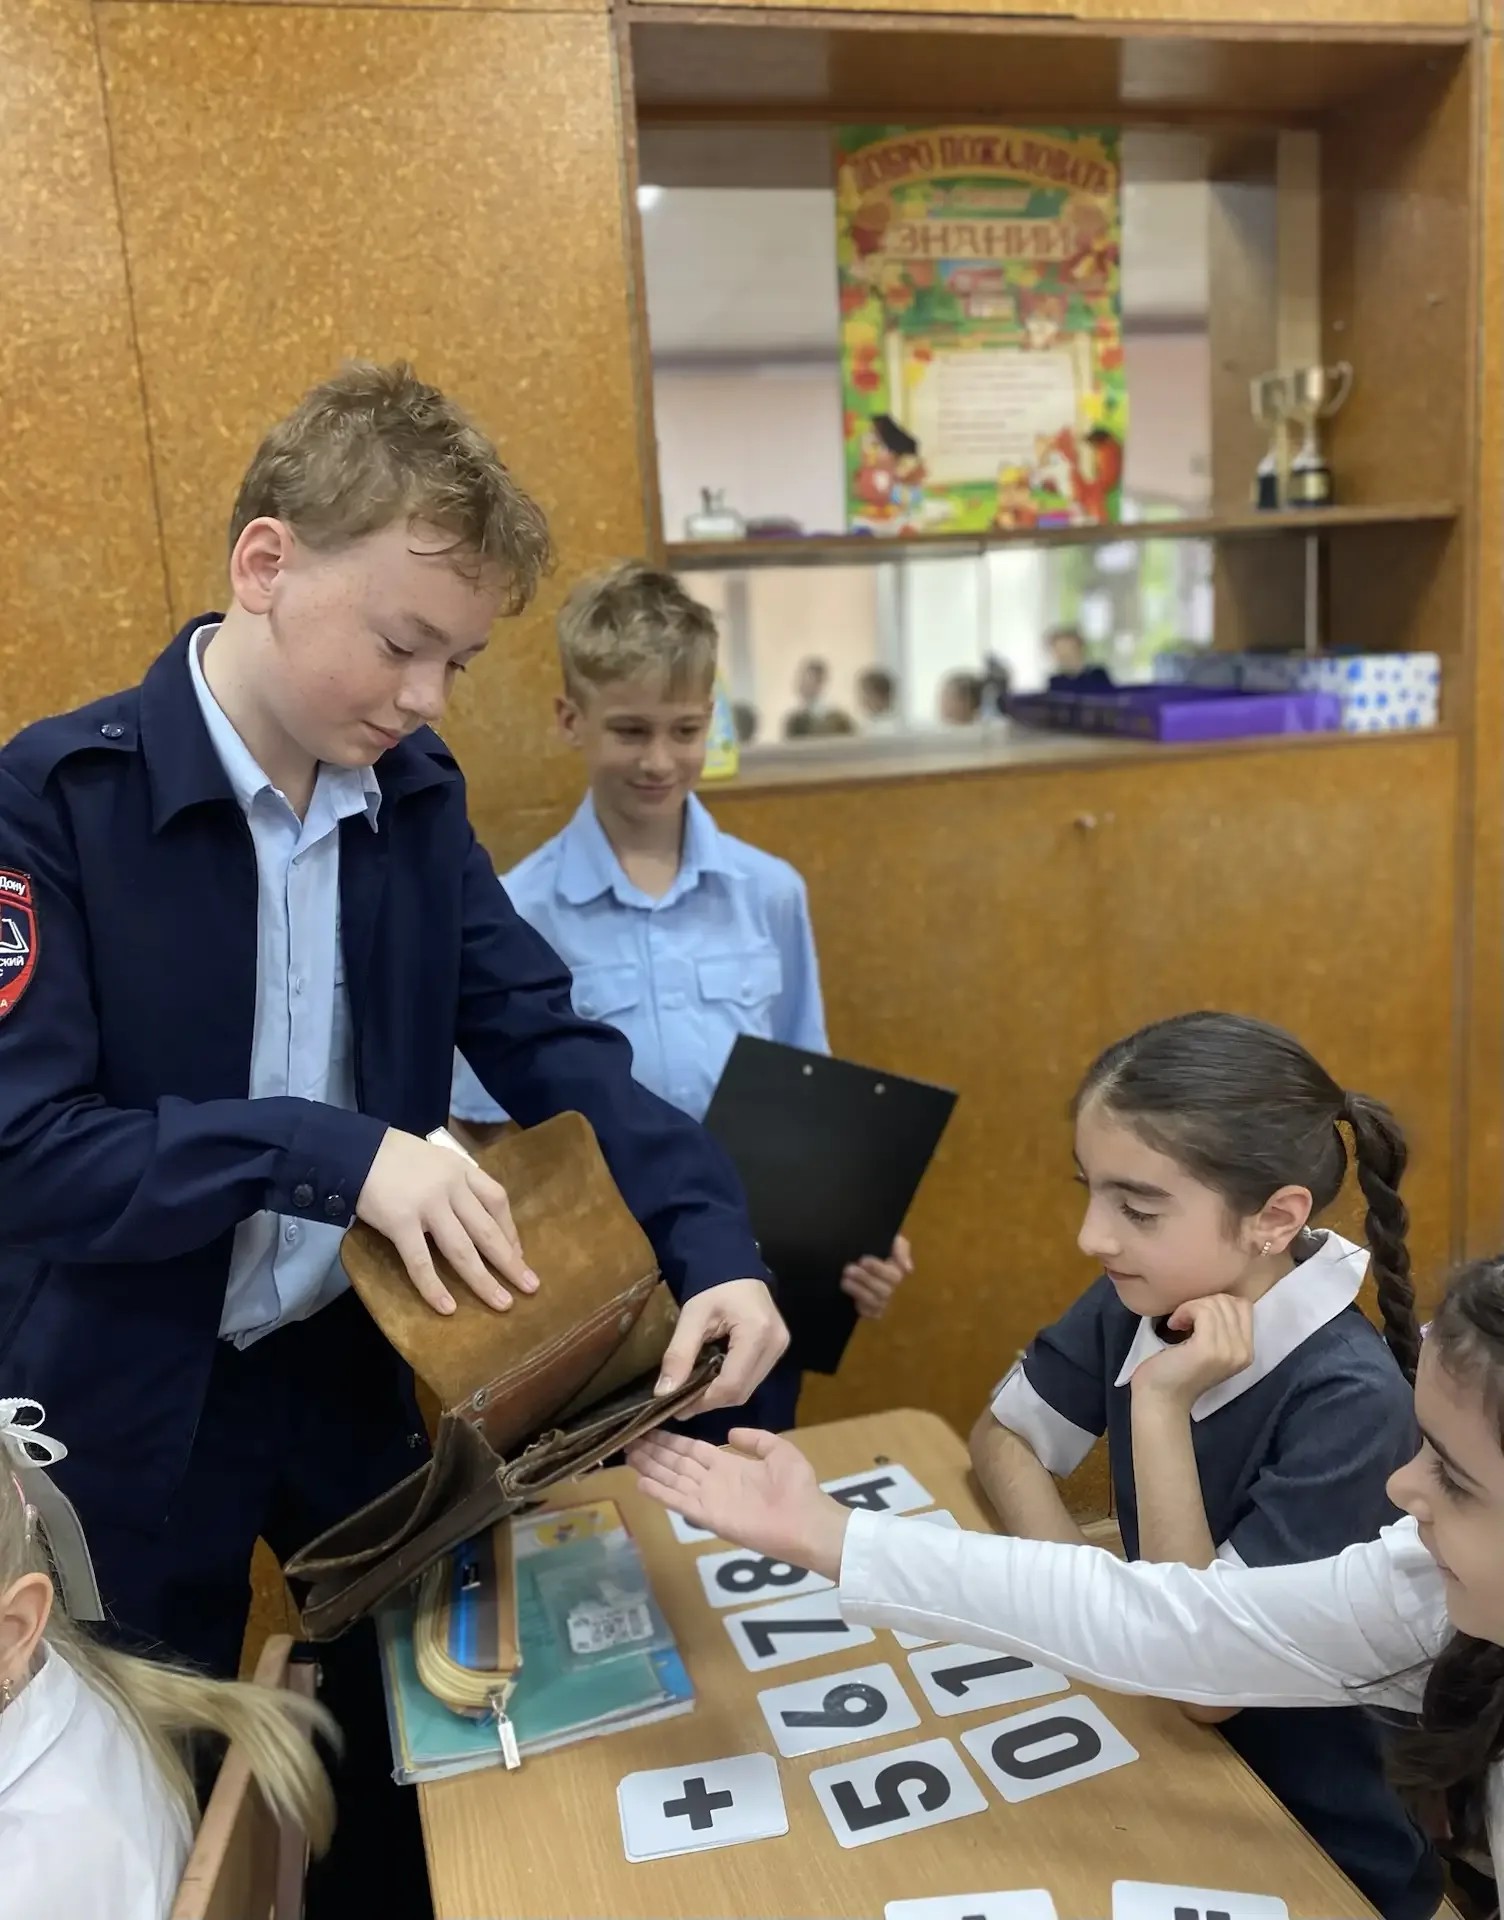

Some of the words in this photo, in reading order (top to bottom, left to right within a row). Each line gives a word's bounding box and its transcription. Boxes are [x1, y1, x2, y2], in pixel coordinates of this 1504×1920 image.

[716, 1556, 809, 1593] 8
[741, 1619, 850, 1658] 7
[931, 1656, 1034, 1697] 1
[830, 1760, 951, 1832] 5
